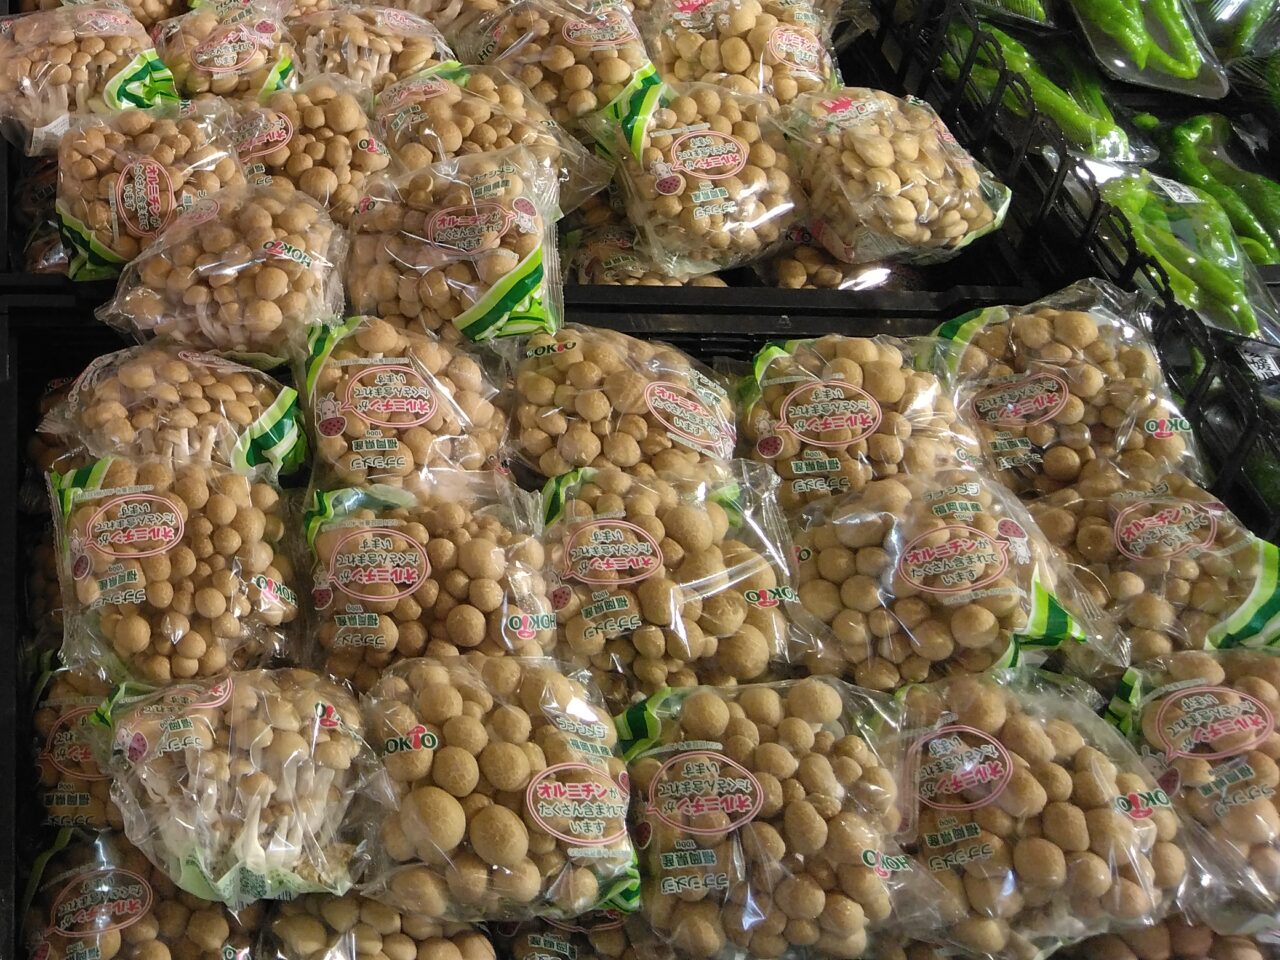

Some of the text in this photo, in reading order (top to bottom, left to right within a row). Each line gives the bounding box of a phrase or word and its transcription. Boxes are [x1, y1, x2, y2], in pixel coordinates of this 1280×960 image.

[355, 399, 431, 414] オルニチンが
[906, 537, 990, 566] オルニチンが
[338, 566, 420, 585] オルニチンが
[508, 612, 557, 640] HOKTO
[384, 725, 438, 756] OKTO
[662, 794, 753, 815] オルニチンが
[570, 820, 605, 834] います
